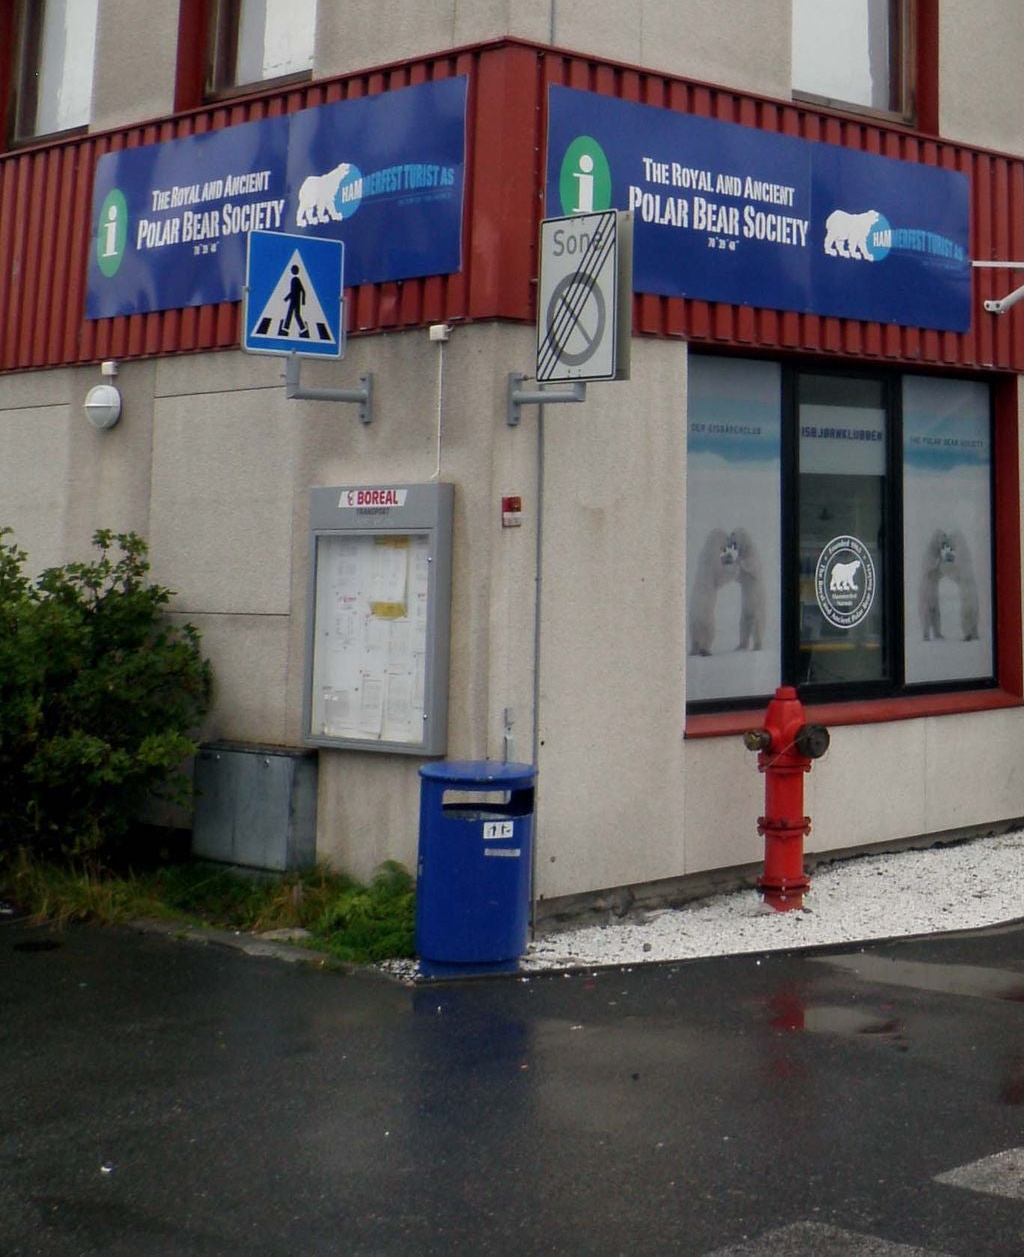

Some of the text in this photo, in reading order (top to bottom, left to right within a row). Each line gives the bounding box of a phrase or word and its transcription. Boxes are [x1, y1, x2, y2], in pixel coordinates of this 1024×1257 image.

[152, 171, 271, 212] THE ROYAL AND ANCIENT
[404, 164, 440, 189] TURIST
[440, 166, 455, 186] AS
[642, 157, 795, 207] THE ROYAL AND ANCIENT
[136, 218, 180, 250] POLAR
[182, 211, 219, 242] BEAR
[222, 199, 285, 236] SOCIETY
[629, 186, 808, 247] POLAR BEAR SOCIETY
[553, 229, 603, 257] Sone
[357, 490, 398, 505] BOREAL
